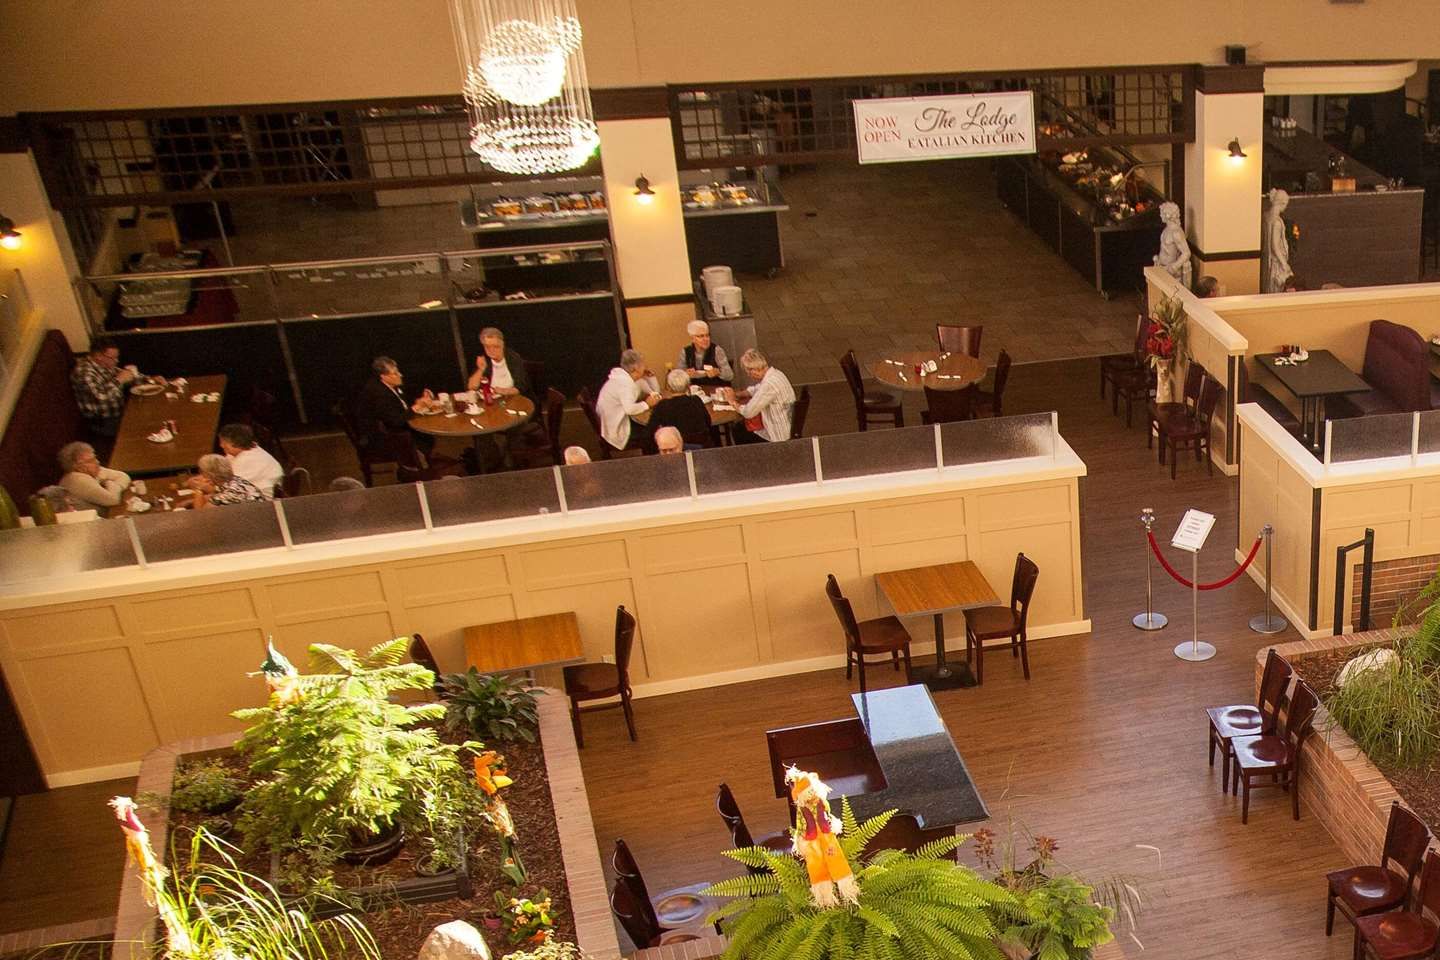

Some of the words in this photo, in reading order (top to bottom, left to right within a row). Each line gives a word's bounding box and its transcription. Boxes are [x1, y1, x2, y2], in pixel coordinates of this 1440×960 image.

[864, 116, 898, 129] NOW
[914, 107, 956, 133] The
[961, 101, 1017, 135] Lodge
[864, 130, 901, 143] OPEN
[971, 132, 1026, 145] KITCHEN
